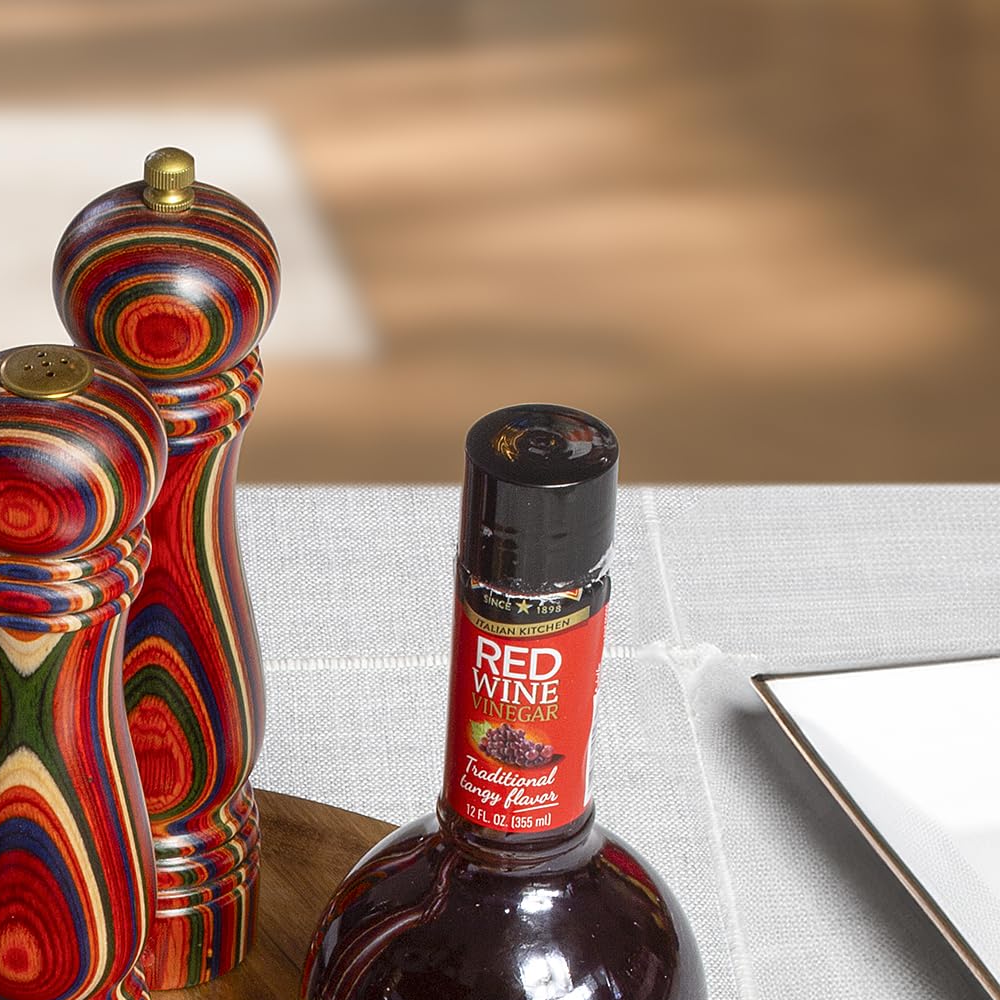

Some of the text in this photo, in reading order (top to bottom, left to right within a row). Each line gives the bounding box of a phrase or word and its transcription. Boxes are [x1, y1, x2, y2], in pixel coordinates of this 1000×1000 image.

[483, 594, 562, 614] SINCE 1898
[475, 618, 570, 636] ITALIAN KITCHEN
[475, 635, 562, 681] RED
[472, 666, 560, 705] WINE
[471, 693, 559, 722] VINEGAR
[465, 755, 558, 787] Traditional
[460, 774, 559, 808] tangy flavor
[466, 804, 476, 817] 12
[477, 811, 491, 824] FL.
[493, 815, 508, 827] OZ.
[511, 814, 533, 829] (355
